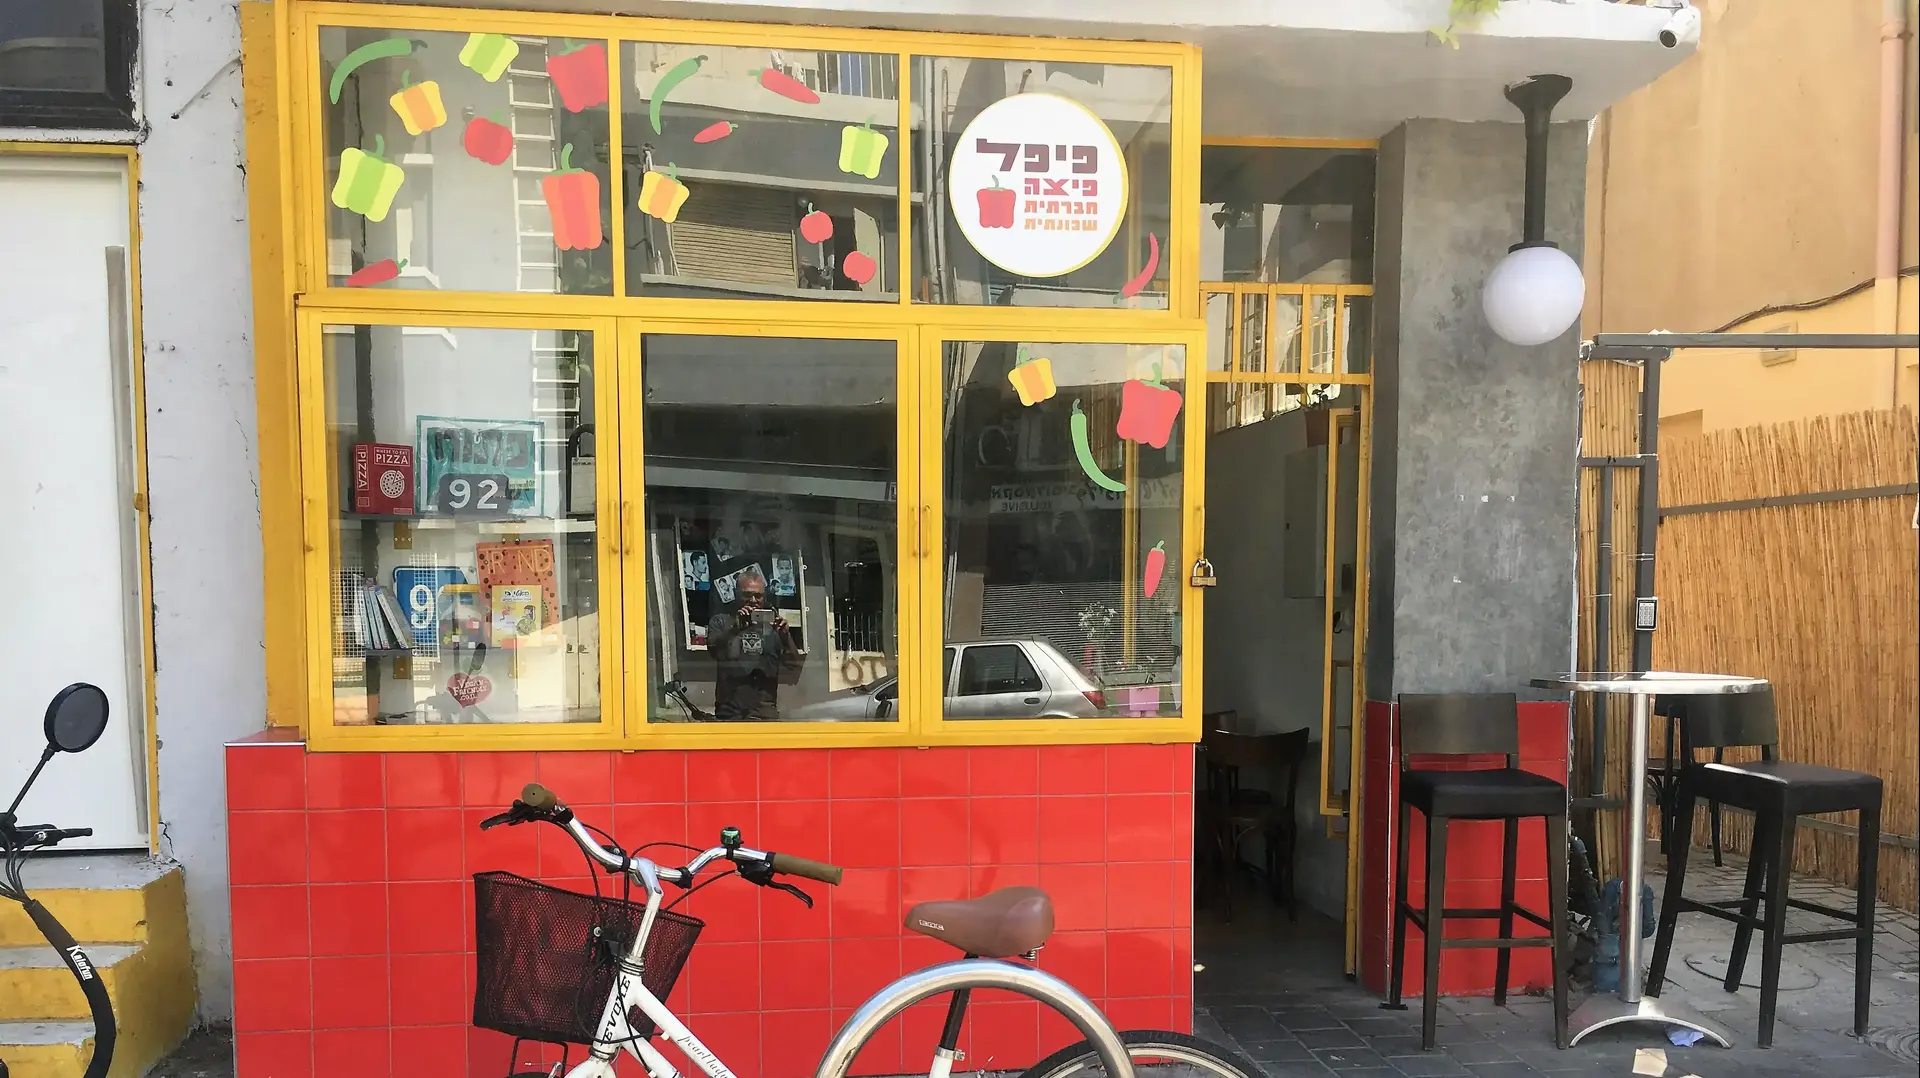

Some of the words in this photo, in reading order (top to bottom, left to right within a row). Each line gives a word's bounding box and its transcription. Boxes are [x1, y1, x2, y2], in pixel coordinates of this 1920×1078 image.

[976, 138, 1098, 174] פיפל
[1024, 178, 1098, 196] פיצה
[1024, 200, 1098, 215] חברתית
[1024, 218, 1098, 231] שכונתית
[376, 453, 409, 465] PIZZA
[358, 451, 367, 488] PIZZA
[449, 479, 500, 509] 92
